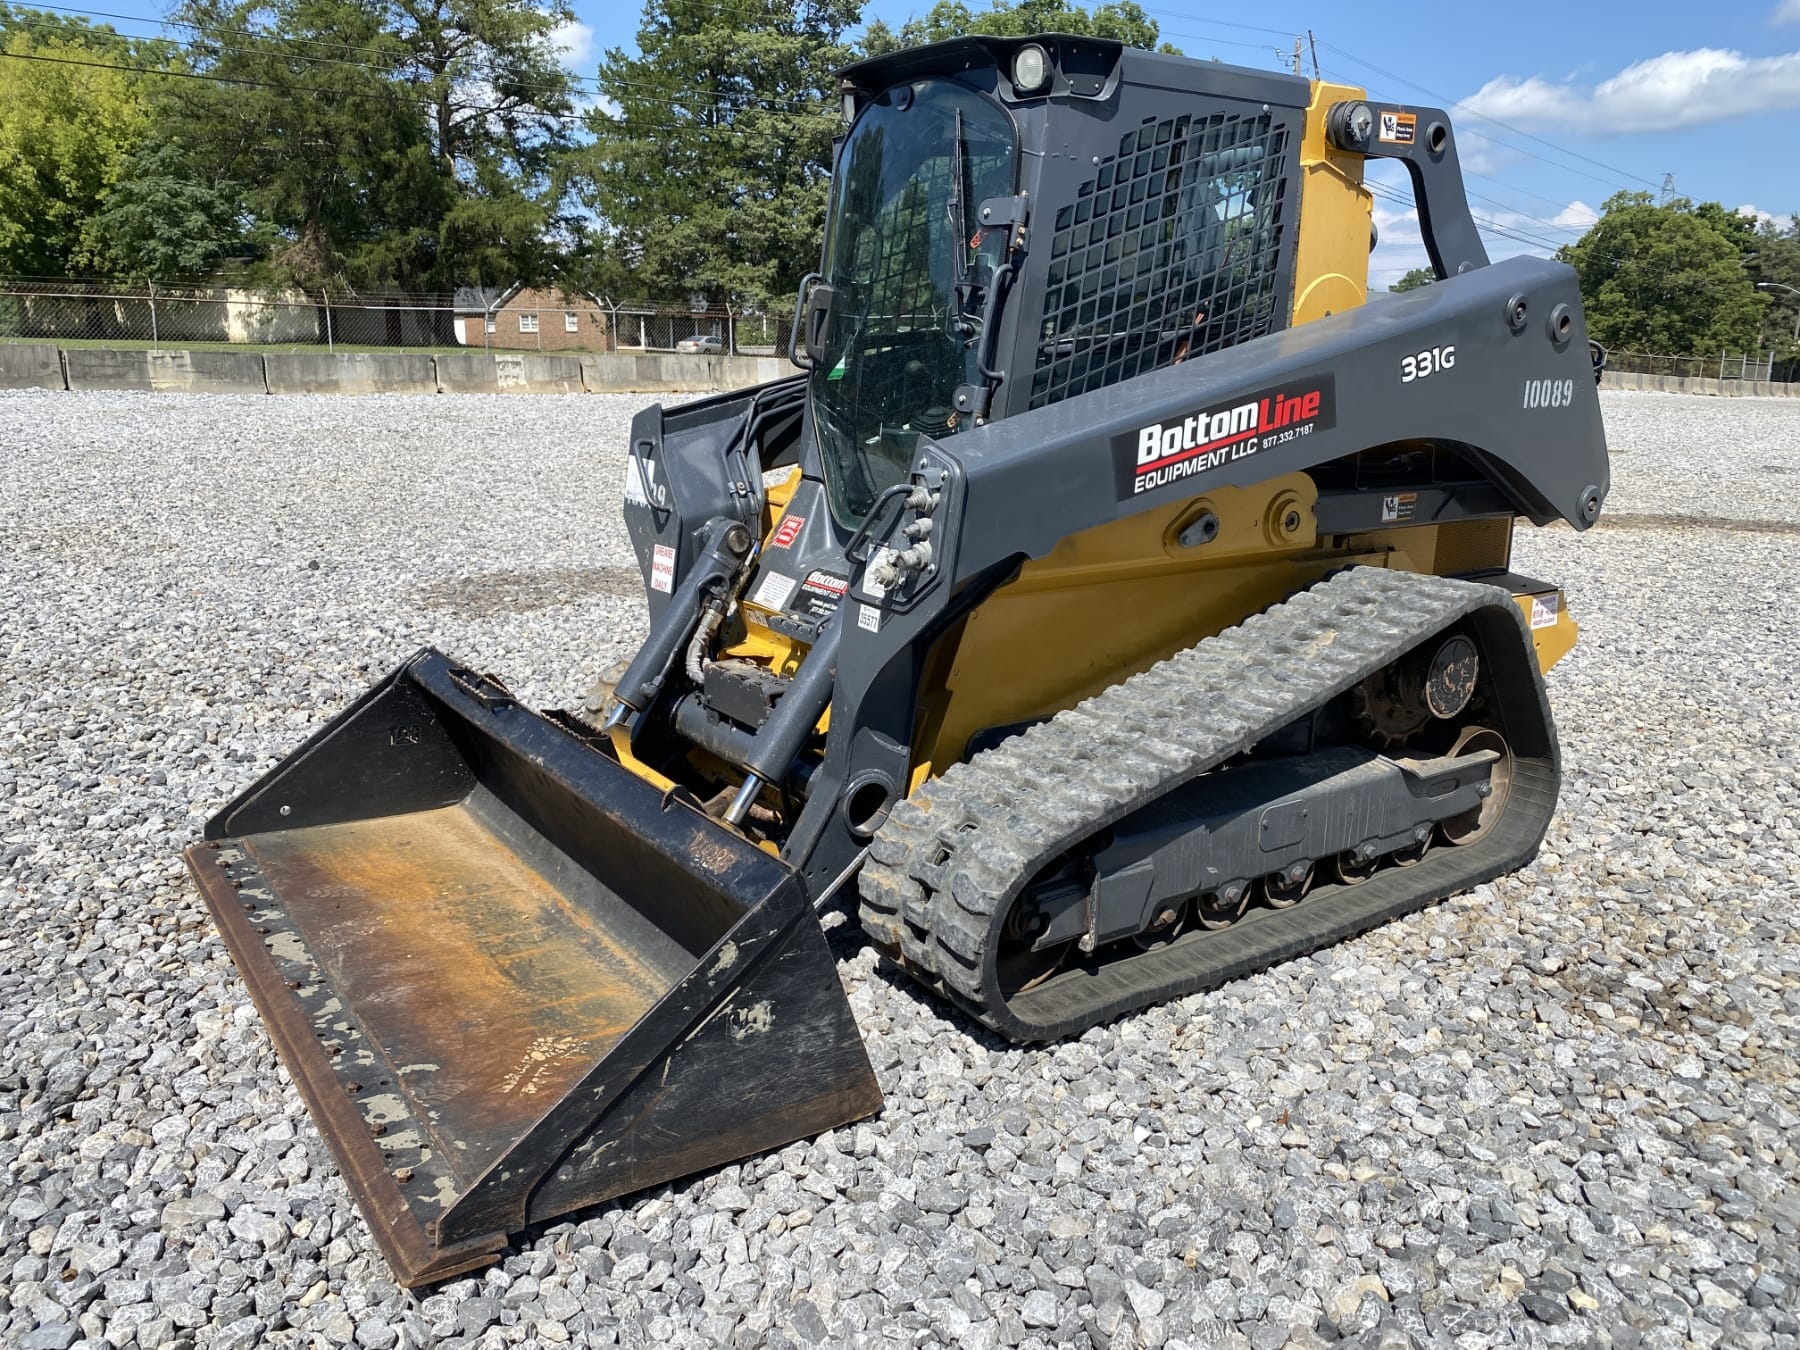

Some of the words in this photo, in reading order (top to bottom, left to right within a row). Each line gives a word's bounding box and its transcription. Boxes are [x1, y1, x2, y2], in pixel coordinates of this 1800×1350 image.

[1402, 346, 1455, 383] 331G
[1523, 379, 1573, 408] 10089
[1137, 390, 1321, 466] BottomLine
[1134, 447, 1230, 494] EQUIPMENT
[1231, 437, 1258, 461] LLC
[1262, 422, 1314, 449] 877.332.7187
